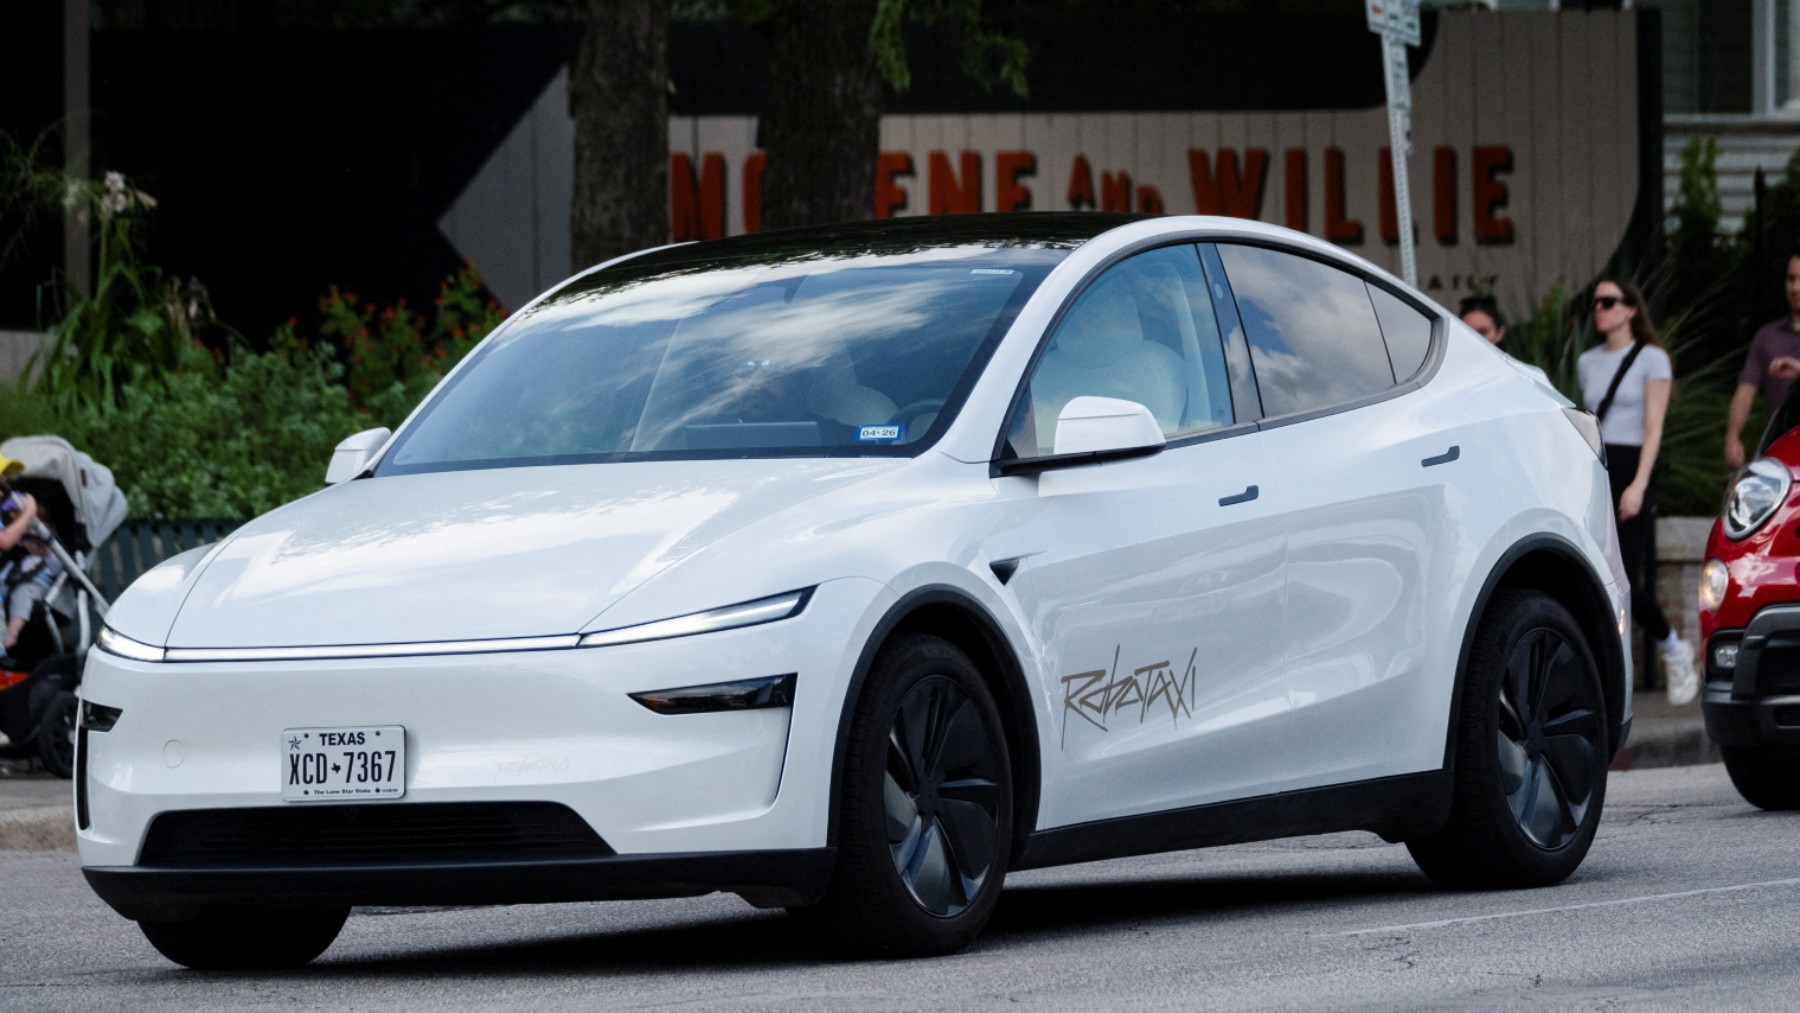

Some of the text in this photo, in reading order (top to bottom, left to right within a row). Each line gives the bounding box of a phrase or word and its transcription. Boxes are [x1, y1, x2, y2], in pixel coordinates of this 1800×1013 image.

[1067, 154, 1163, 213] AND
[1188, 146, 1514, 243] WILLIE
[319, 732, 365, 746] TEXAS
